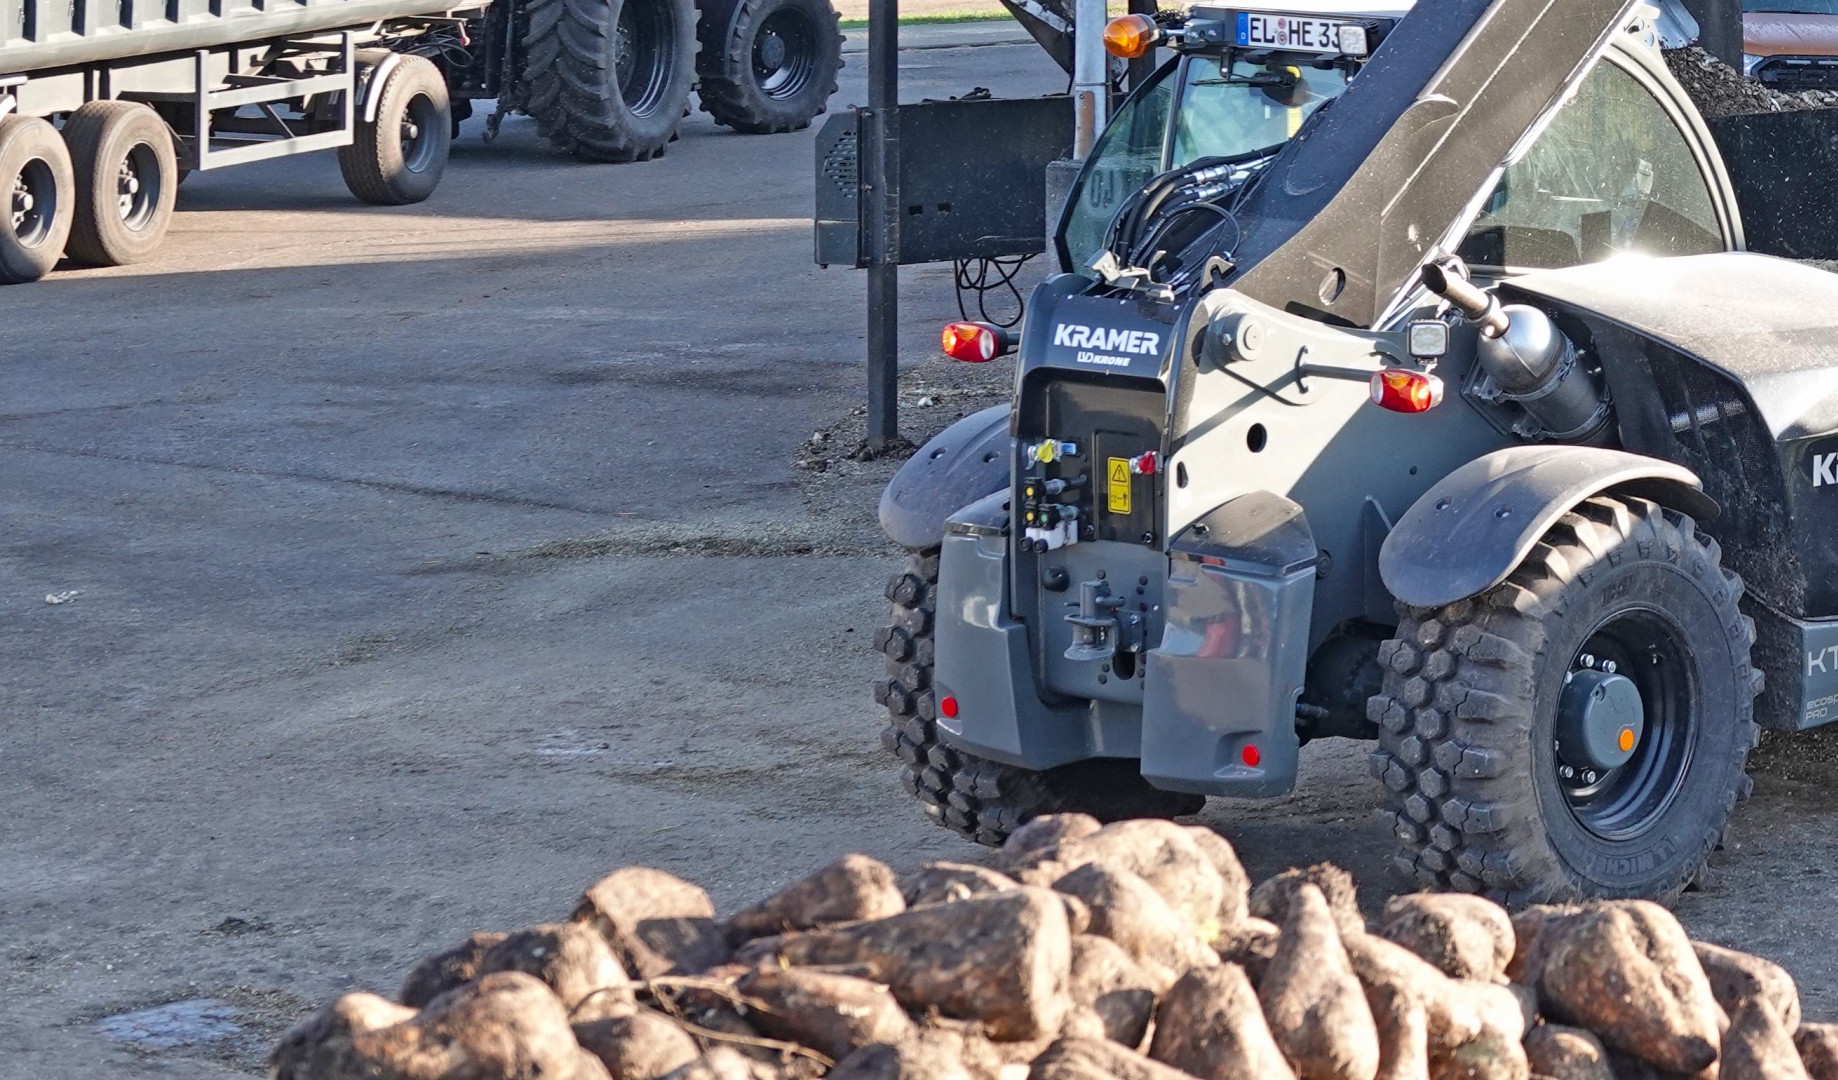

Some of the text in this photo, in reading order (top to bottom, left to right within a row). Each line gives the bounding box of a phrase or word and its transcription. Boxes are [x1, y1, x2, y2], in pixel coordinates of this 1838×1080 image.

[1250, 18, 1275, 43] EL
[1289, 20, 1314, 46] HE
[1054, 323, 1159, 355] KRAMER
[1805, 707, 1828, 721] PRO
